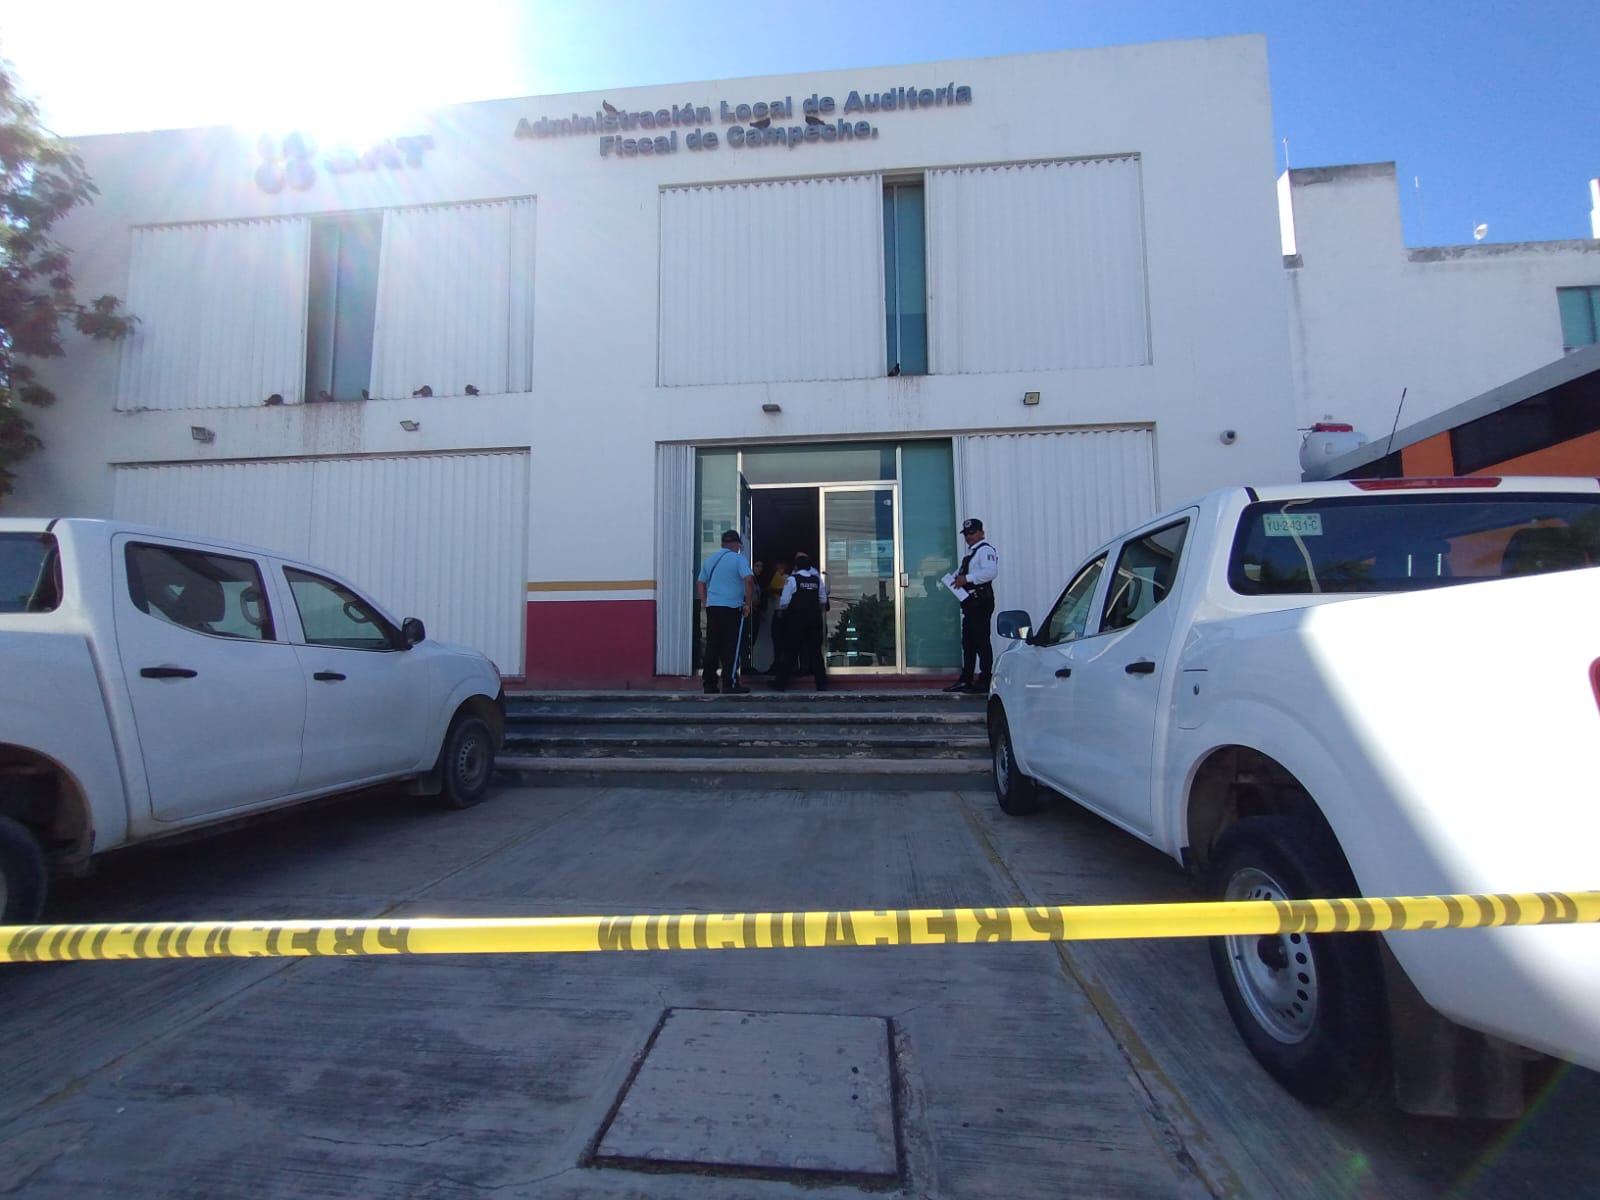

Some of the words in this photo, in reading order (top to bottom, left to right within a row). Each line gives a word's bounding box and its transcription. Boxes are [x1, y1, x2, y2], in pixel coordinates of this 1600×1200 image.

[514, 102, 711, 138] Administración
[720, 96, 793, 120] Local
[802, 92, 835, 114] de
[845, 82, 972, 113] Auditoría
[601, 130, 678, 157] Fiscal
[686, 126, 719, 149] de
